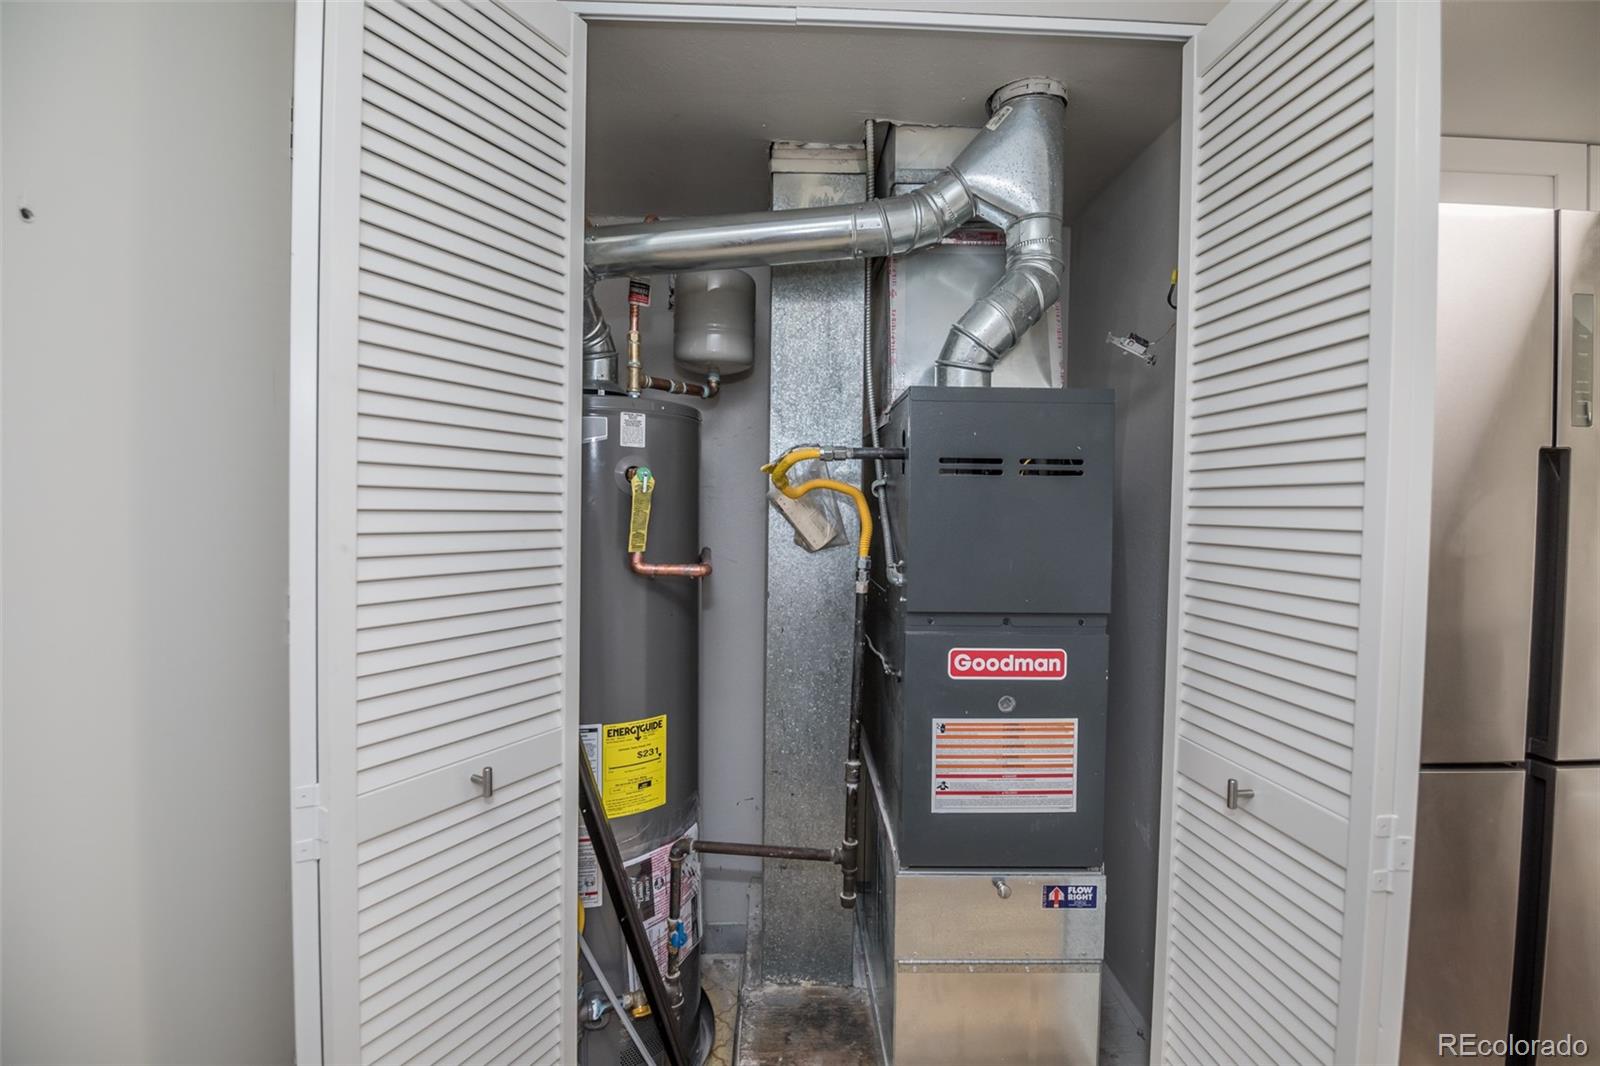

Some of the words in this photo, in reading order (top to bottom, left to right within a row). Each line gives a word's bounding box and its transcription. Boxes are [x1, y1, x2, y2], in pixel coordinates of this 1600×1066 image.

[954, 653, 1061, 672] Goodman
[607, 720, 663, 739] ENERGYGUIDE
[1067, 886, 1093, 894] FLOW
[1067, 893, 1093, 901] RIGHT
